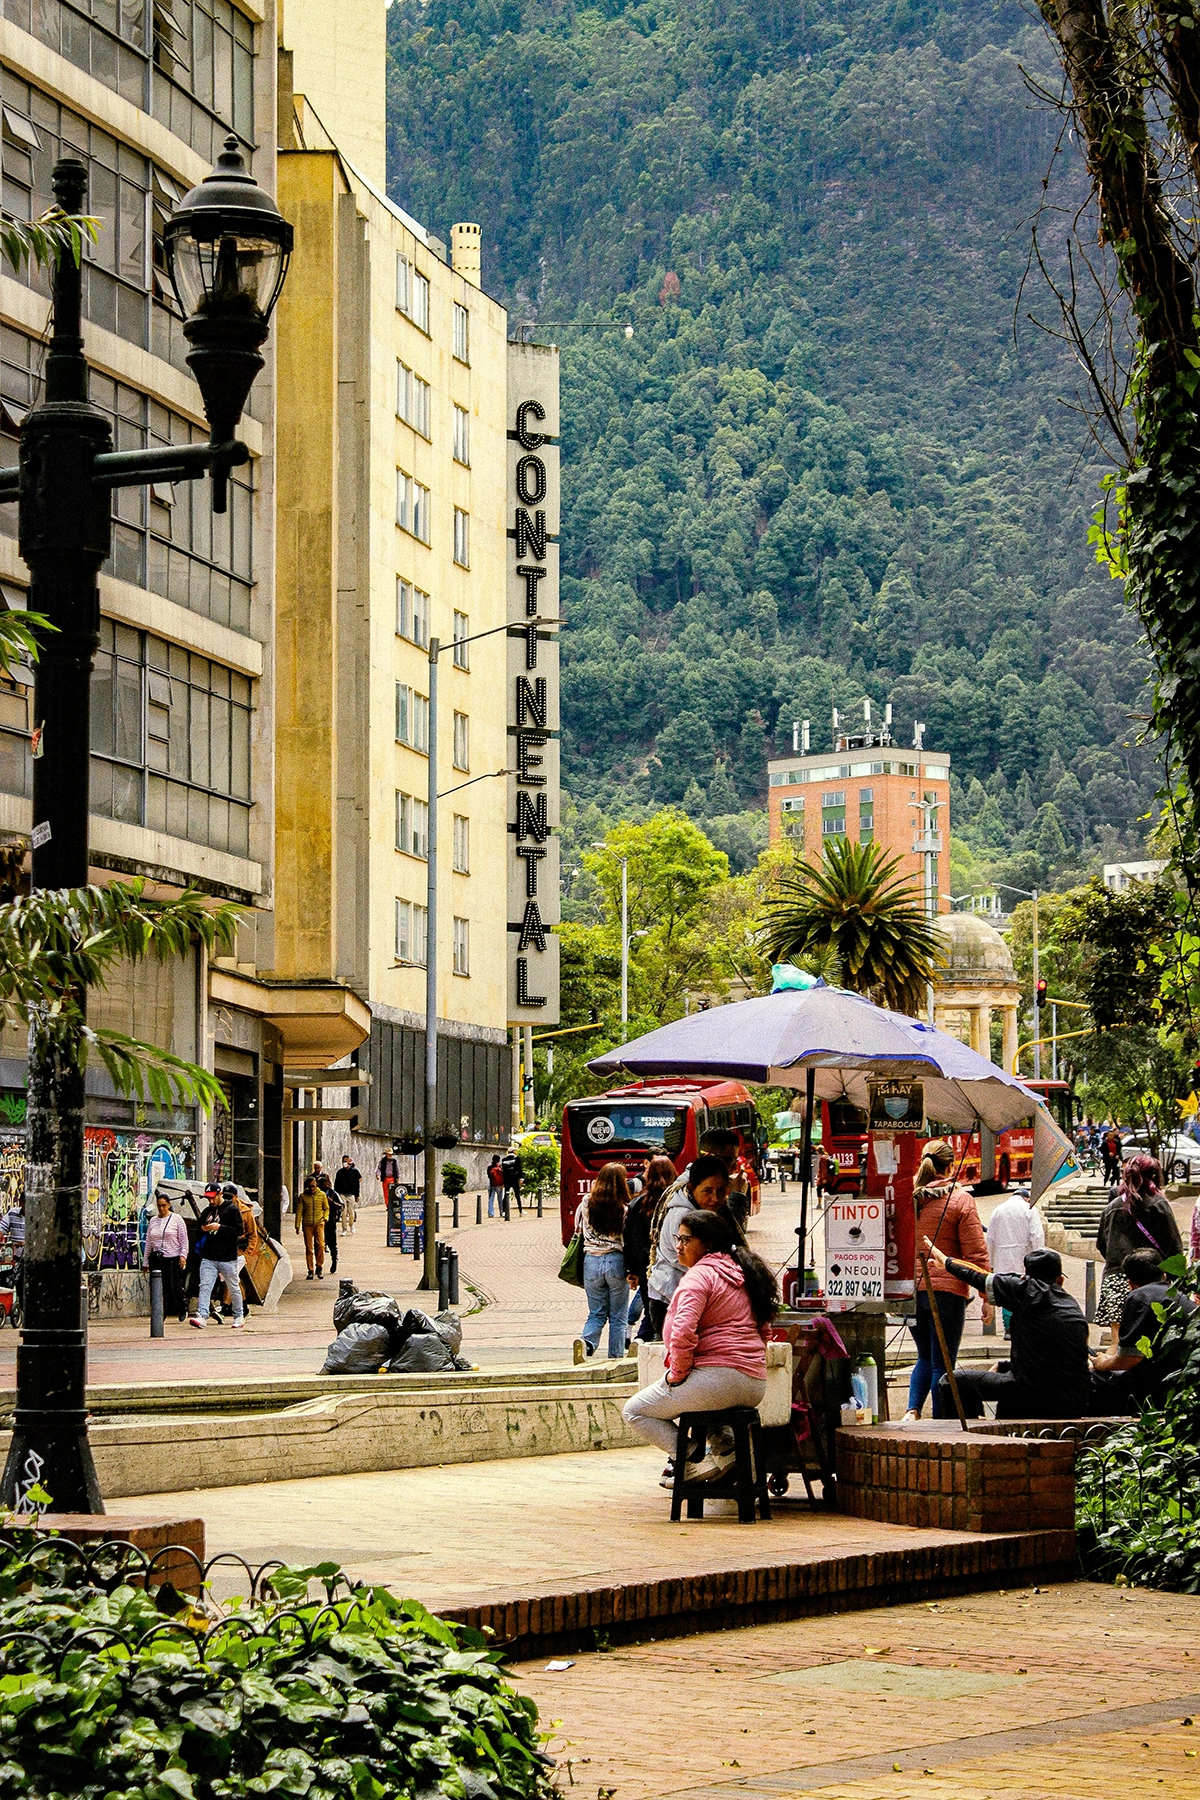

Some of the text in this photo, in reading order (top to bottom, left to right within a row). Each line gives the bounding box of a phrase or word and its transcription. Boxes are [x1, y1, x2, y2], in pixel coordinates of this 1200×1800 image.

[516, 399, 548, 1006] CONTINENTAL
[873, 1120, 921, 1129] TAPABOCAS!
[831, 1204, 880, 1220] TINTO
[834, 1253, 859, 1261] PAGOS
[844, 1265, 881, 1276] NEQUI
[828, 1279, 882, 1298] 322 897 9472
